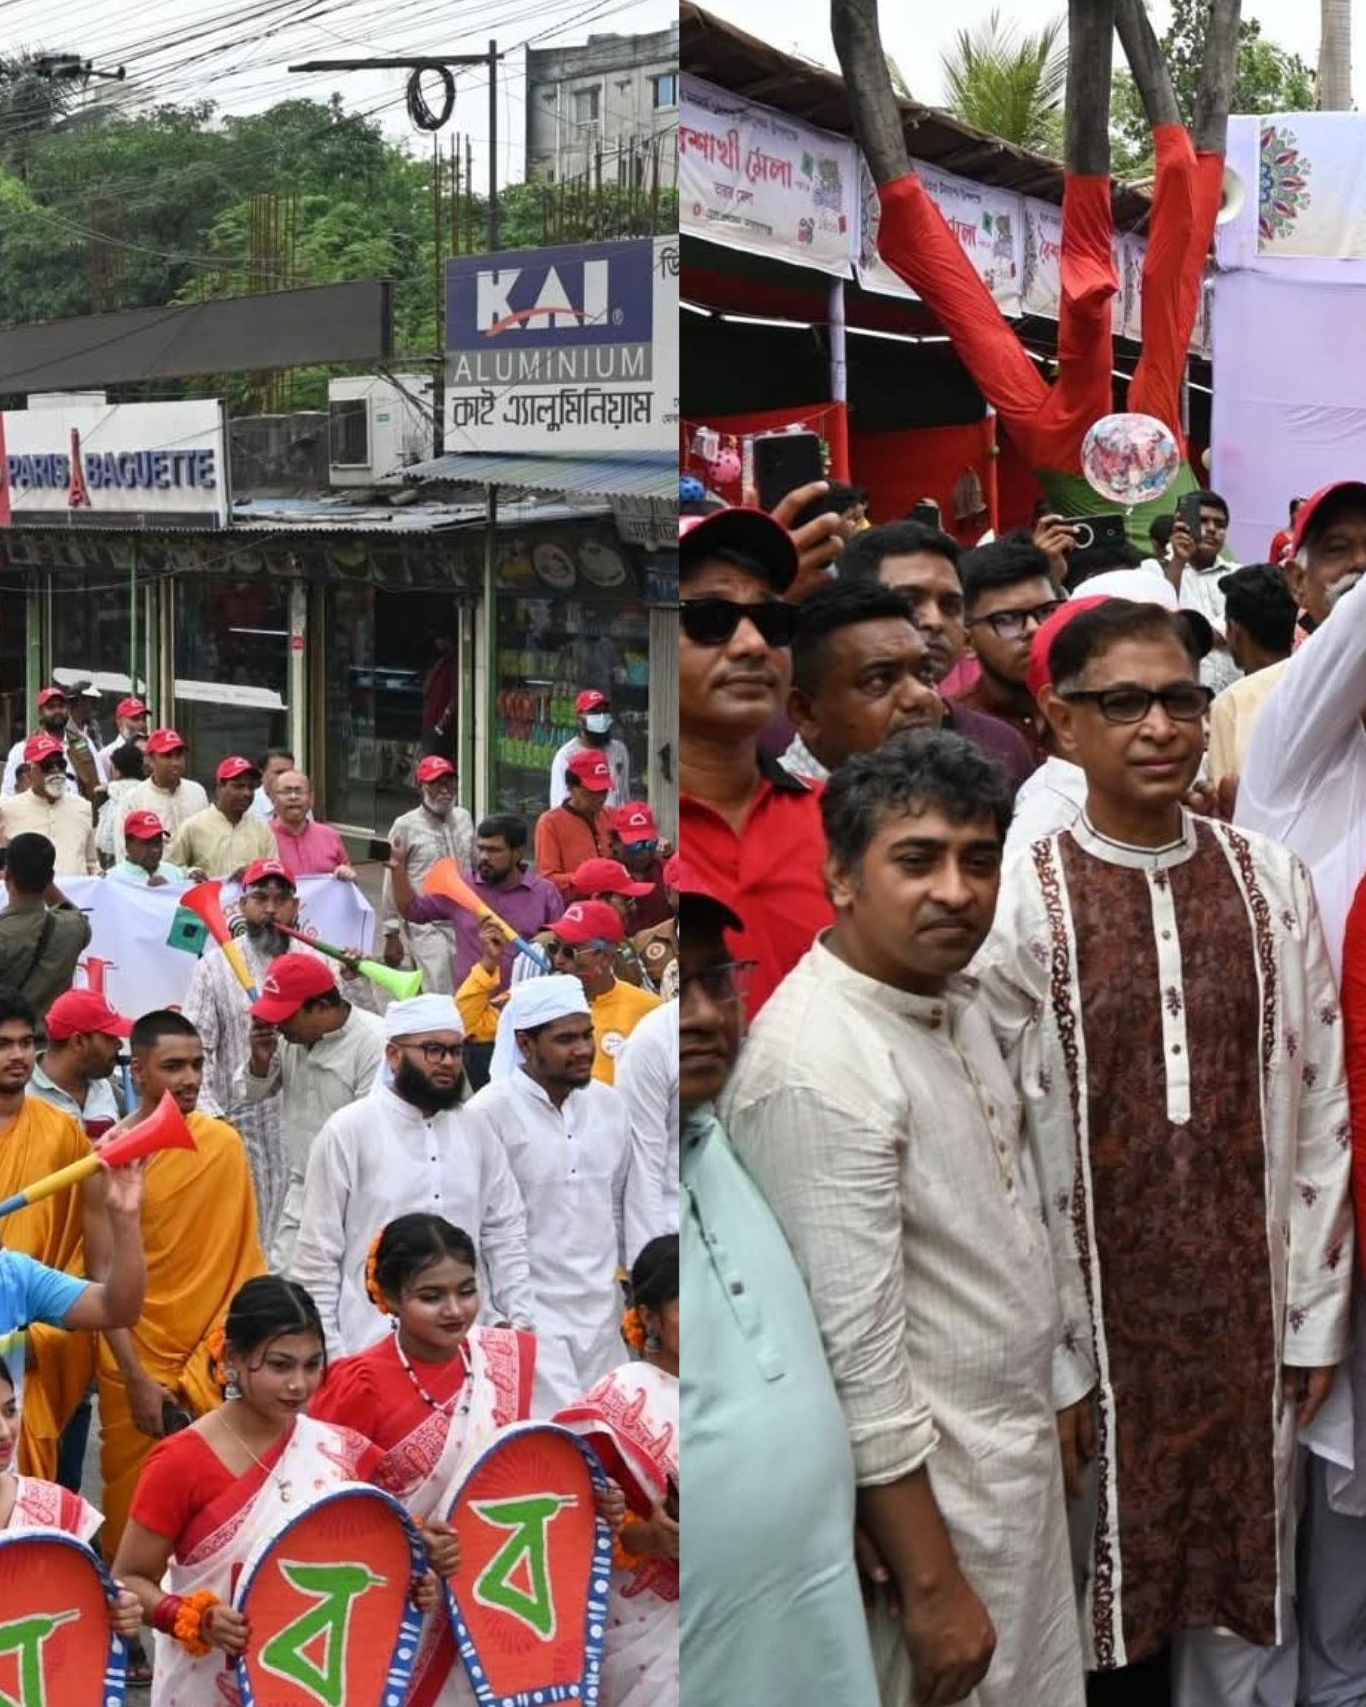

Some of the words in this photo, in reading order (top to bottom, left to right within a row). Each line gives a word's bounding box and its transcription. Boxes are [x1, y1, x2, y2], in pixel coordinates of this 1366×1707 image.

[679, 125, 741, 173] শাখী
[745, 146, 793, 189] মেলা
[476, 259, 609, 332] KAI
[453, 346, 645, 382] ALUMINIUM
[451, 388, 496, 427] কাই
[502, 387, 655, 432] এ্যালুমিনিয়াম
[7, 453, 71, 489] PARIS
[86, 448, 217, 491] BAGUETTE
